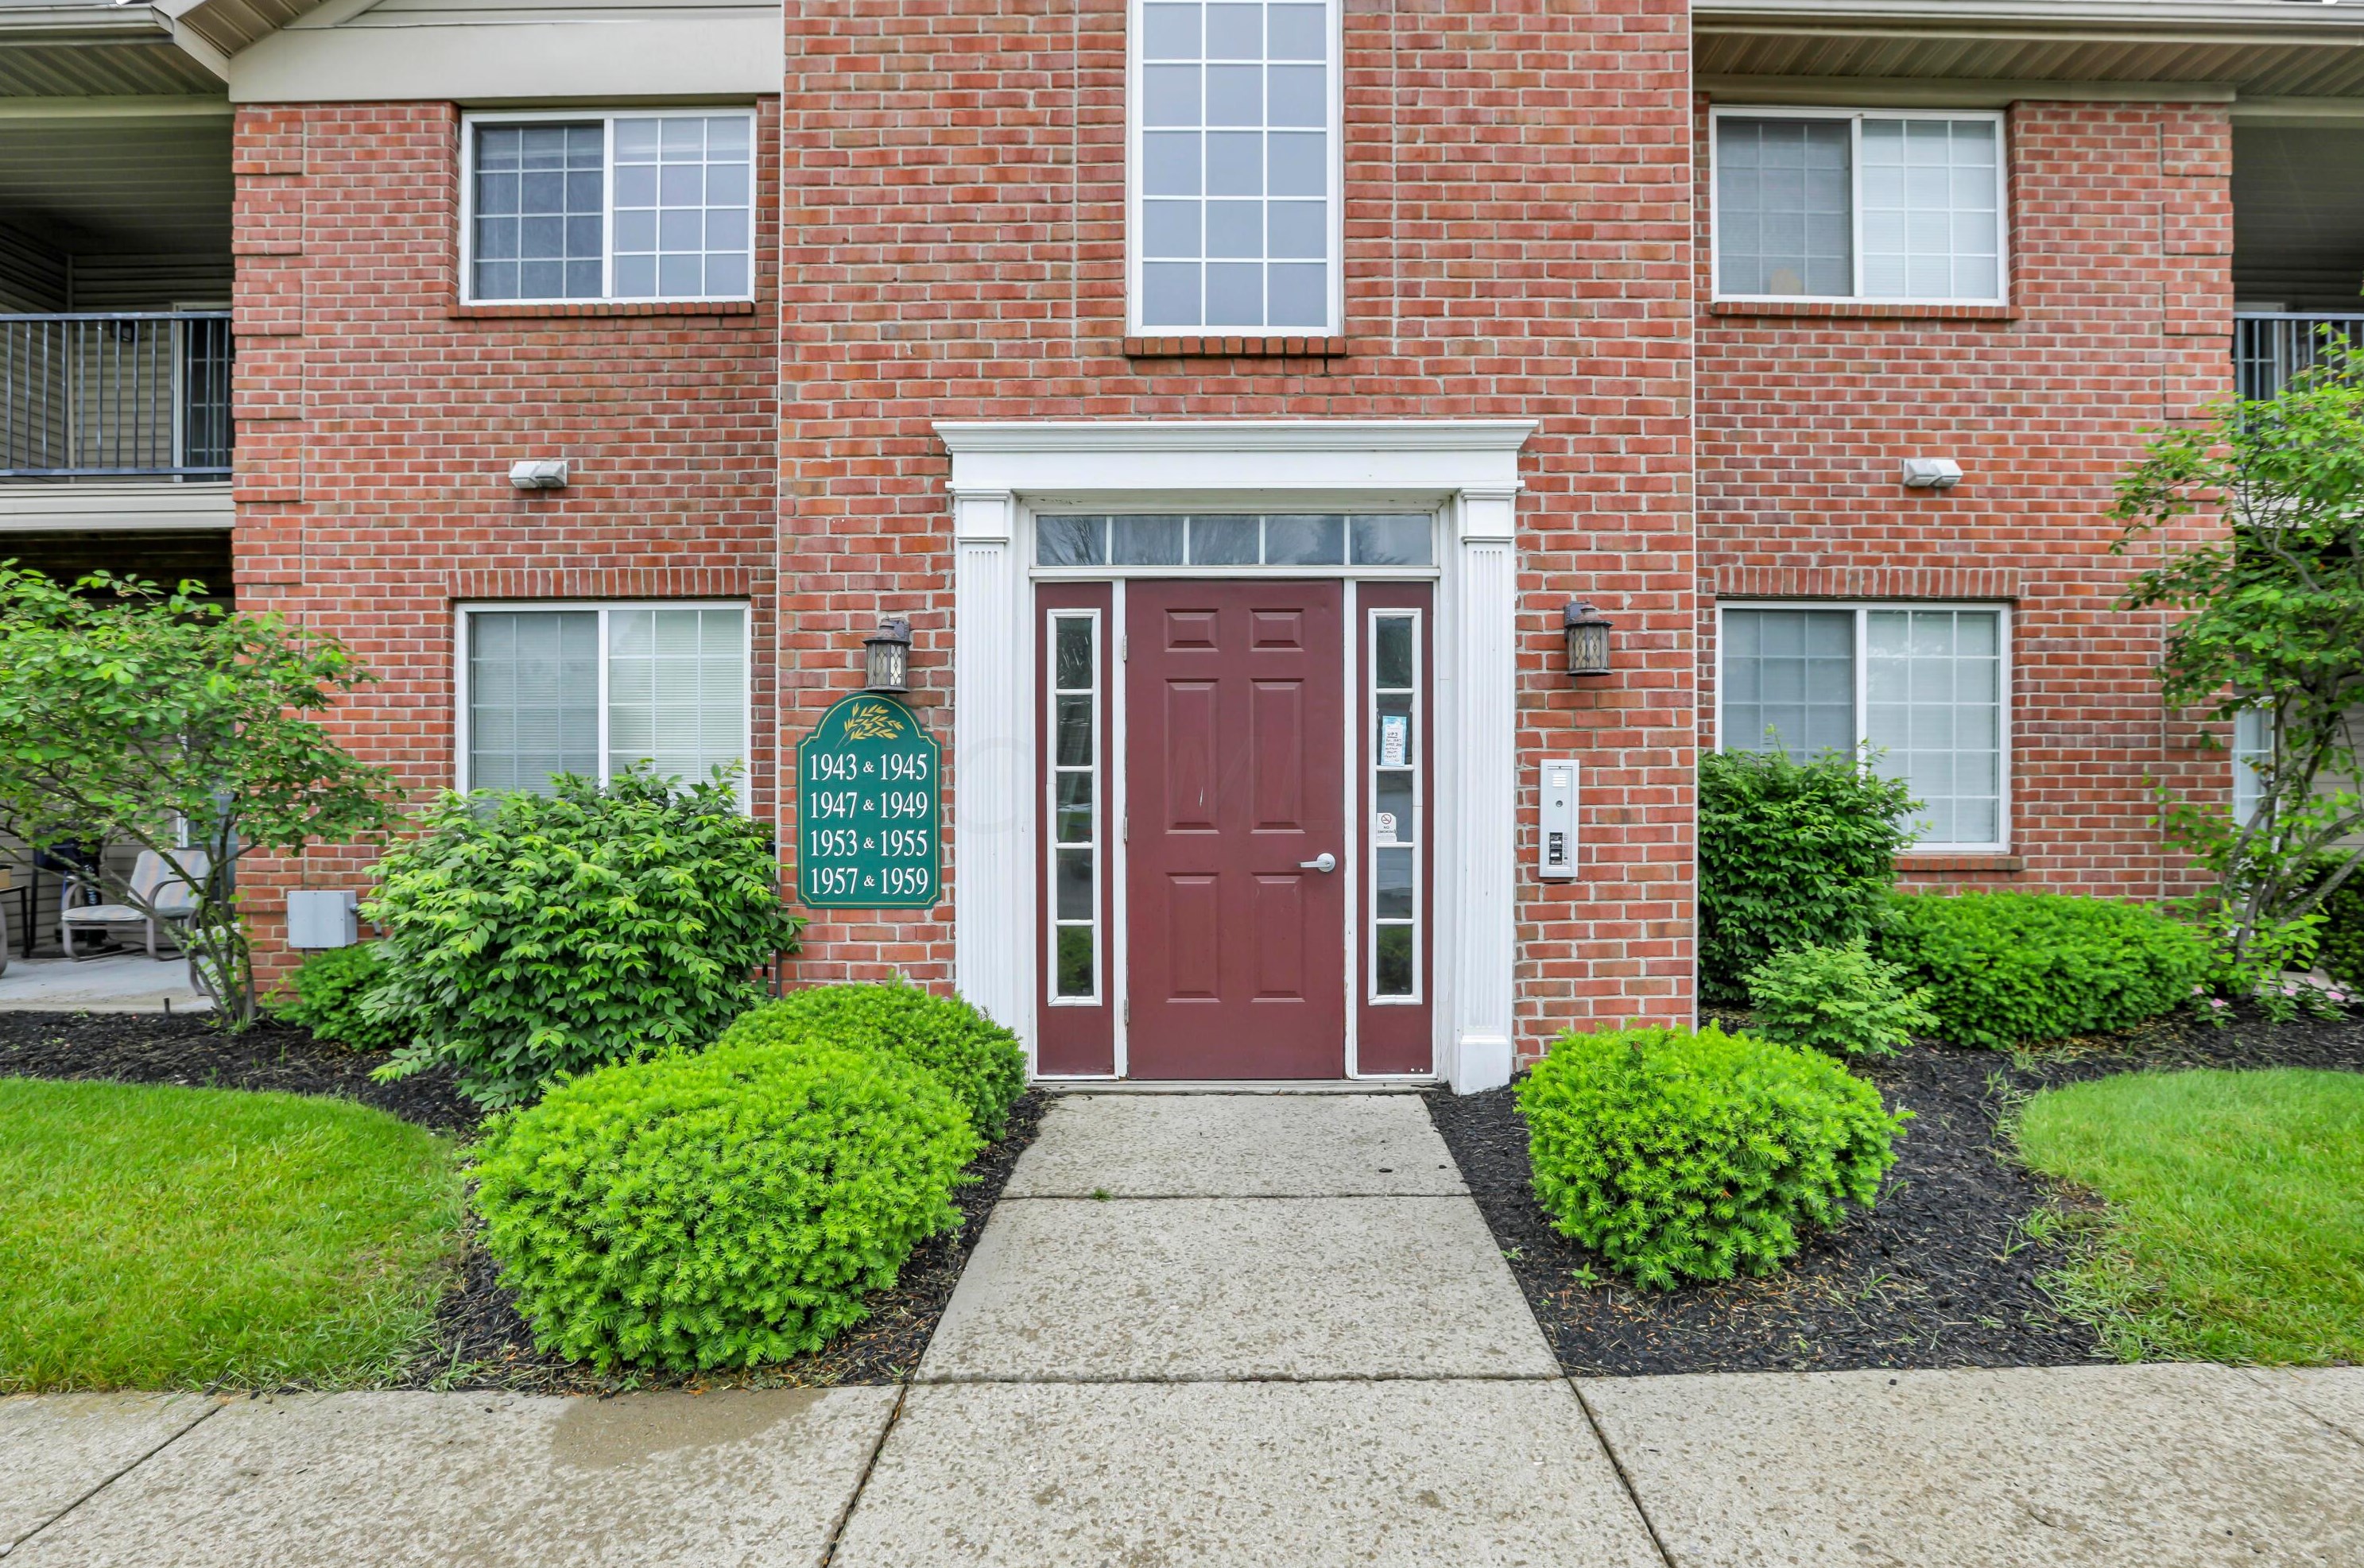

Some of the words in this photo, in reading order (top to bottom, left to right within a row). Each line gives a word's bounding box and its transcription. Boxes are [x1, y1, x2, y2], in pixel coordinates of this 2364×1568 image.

[811, 753, 857, 780] 1943
[862, 761, 874, 773] &
[881, 753, 927, 780] 1945
[811, 792, 857, 819] 1947
[863, 799, 874, 811] &
[881, 792, 927, 819] 1949
[811, 830, 858, 857] 1953
[863, 837, 875, 849] &
[881, 830, 928, 857] 1955
[812, 868, 858, 895] 1957
[863, 875, 875, 887] &
[881, 868, 928, 895] 1959
